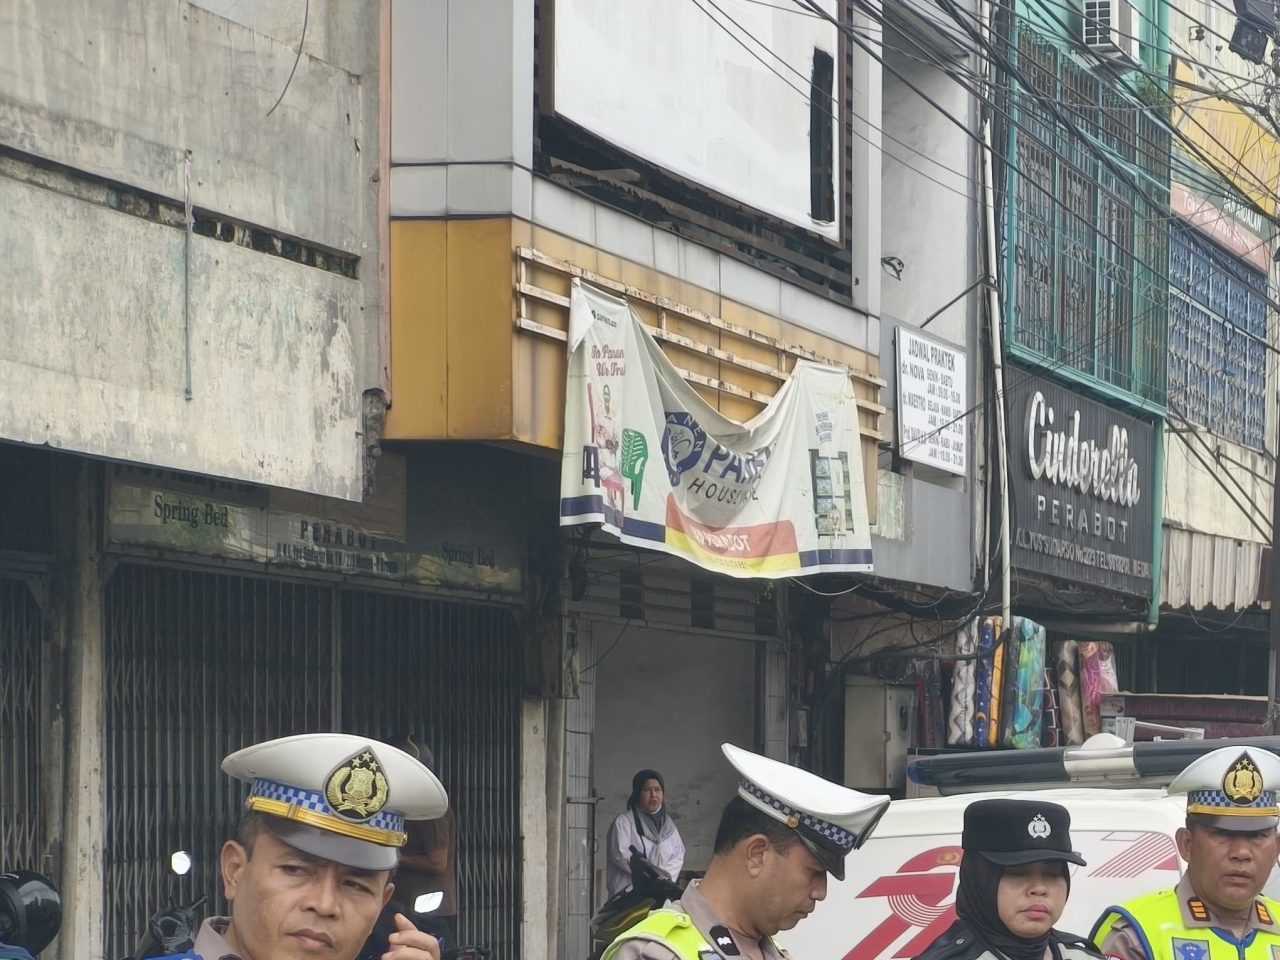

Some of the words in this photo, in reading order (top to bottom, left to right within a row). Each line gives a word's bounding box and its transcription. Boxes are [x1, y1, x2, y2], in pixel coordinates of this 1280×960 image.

[908, 338, 930, 363] JADWAL
[930, 346, 955, 372] PRAKTEK
[910, 362, 925, 381] NOVA
[666, 414, 704, 451] ANEN
[1028, 391, 1141, 507] Cinderella
[154, 494, 199, 528] Spring
[204, 503, 229, 528] Bed
[1037, 495, 1129, 543] PERABOT
[442, 541, 474, 568] Spring
